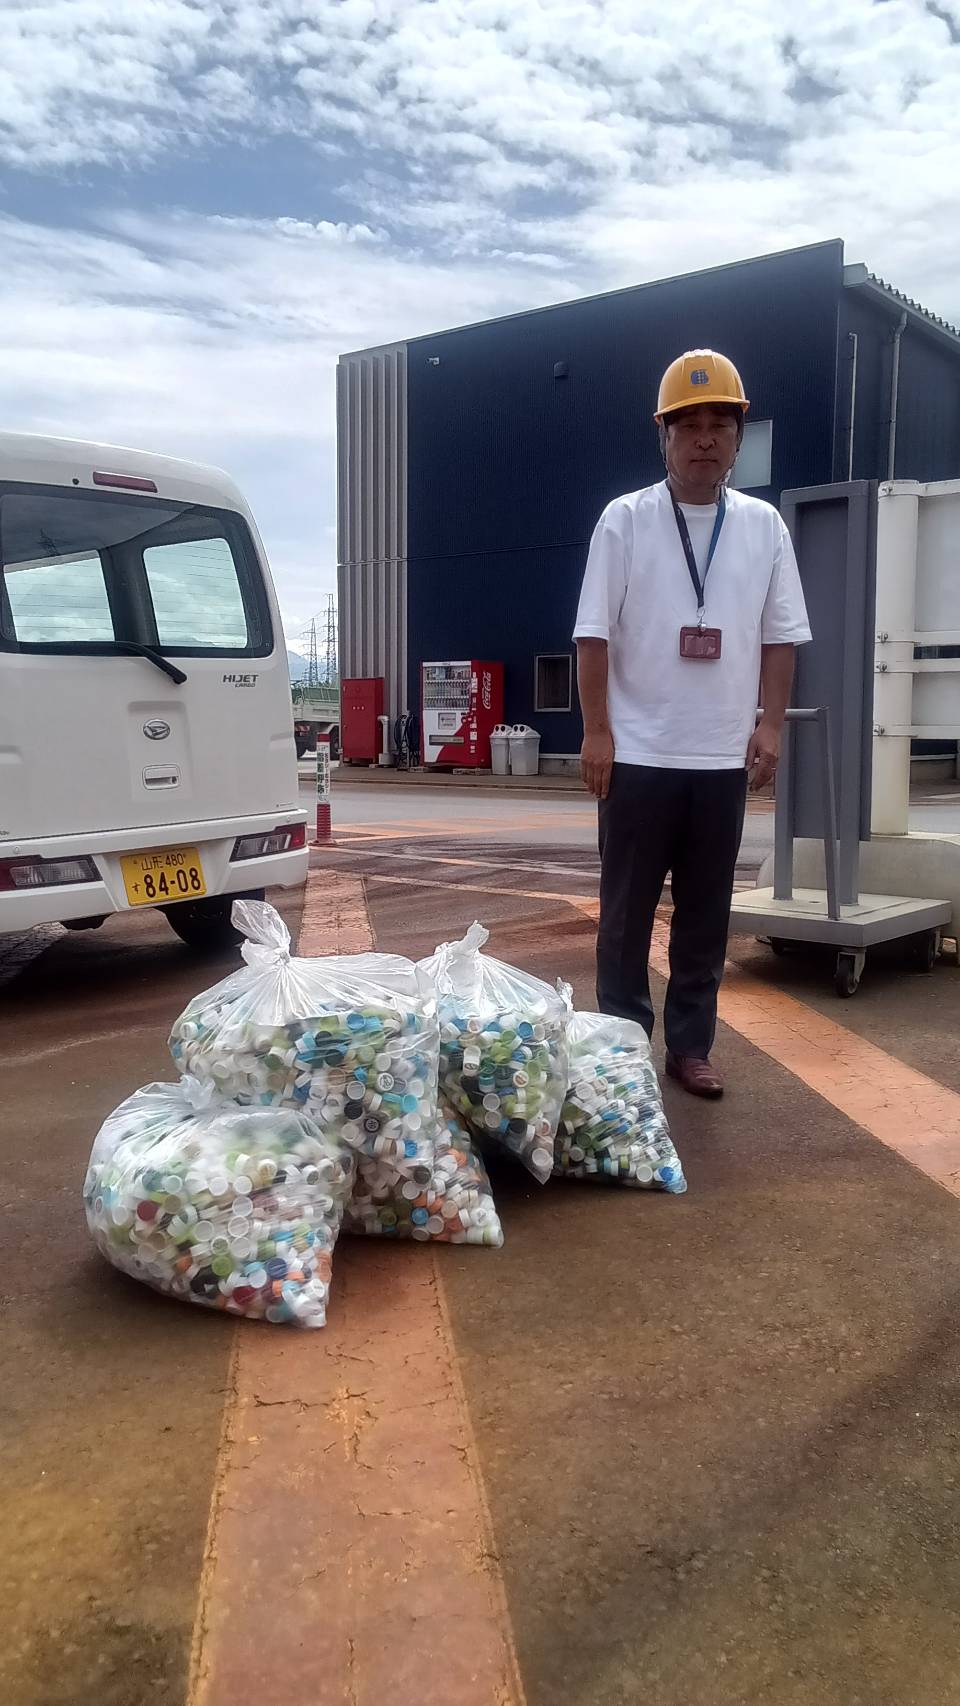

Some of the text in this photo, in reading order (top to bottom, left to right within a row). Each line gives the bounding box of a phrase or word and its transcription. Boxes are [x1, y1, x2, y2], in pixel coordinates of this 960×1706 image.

[222, 674, 259, 683] HIJET
[141, 852, 185, 871] 山形 480
[143, 867, 202, 898] 84-08
